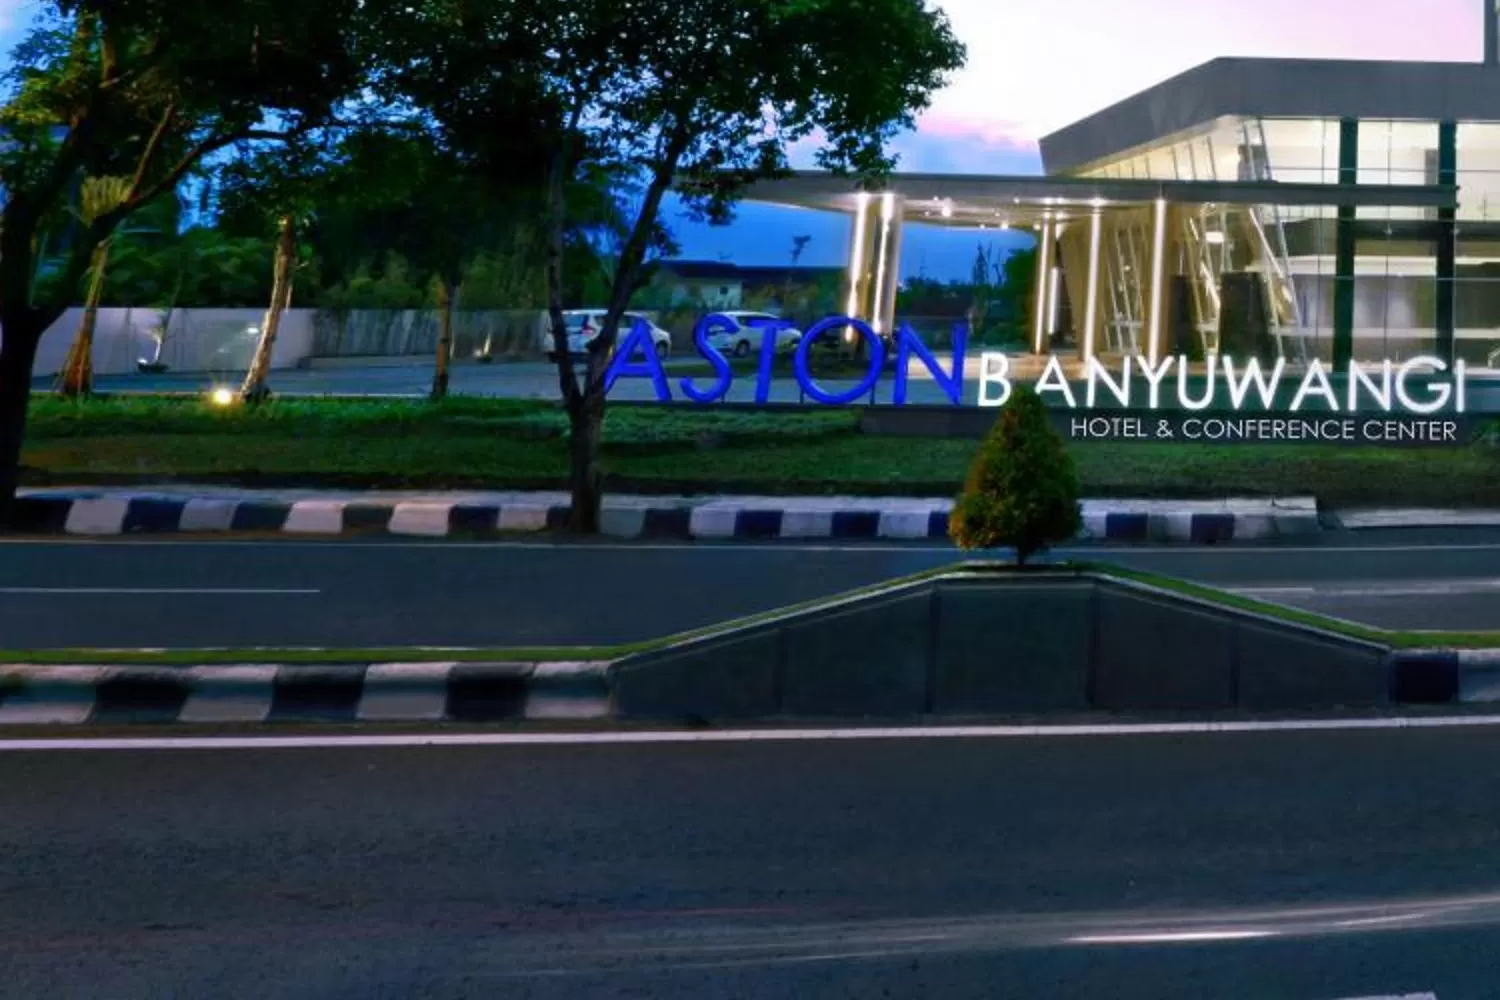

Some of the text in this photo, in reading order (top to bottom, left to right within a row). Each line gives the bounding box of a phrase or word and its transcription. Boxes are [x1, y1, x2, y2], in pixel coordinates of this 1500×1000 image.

[603, 312, 1465, 413] ASTON BANYUWANGI
[1071, 418, 1457, 441] HOTEL & CONFERENCE CENTER
